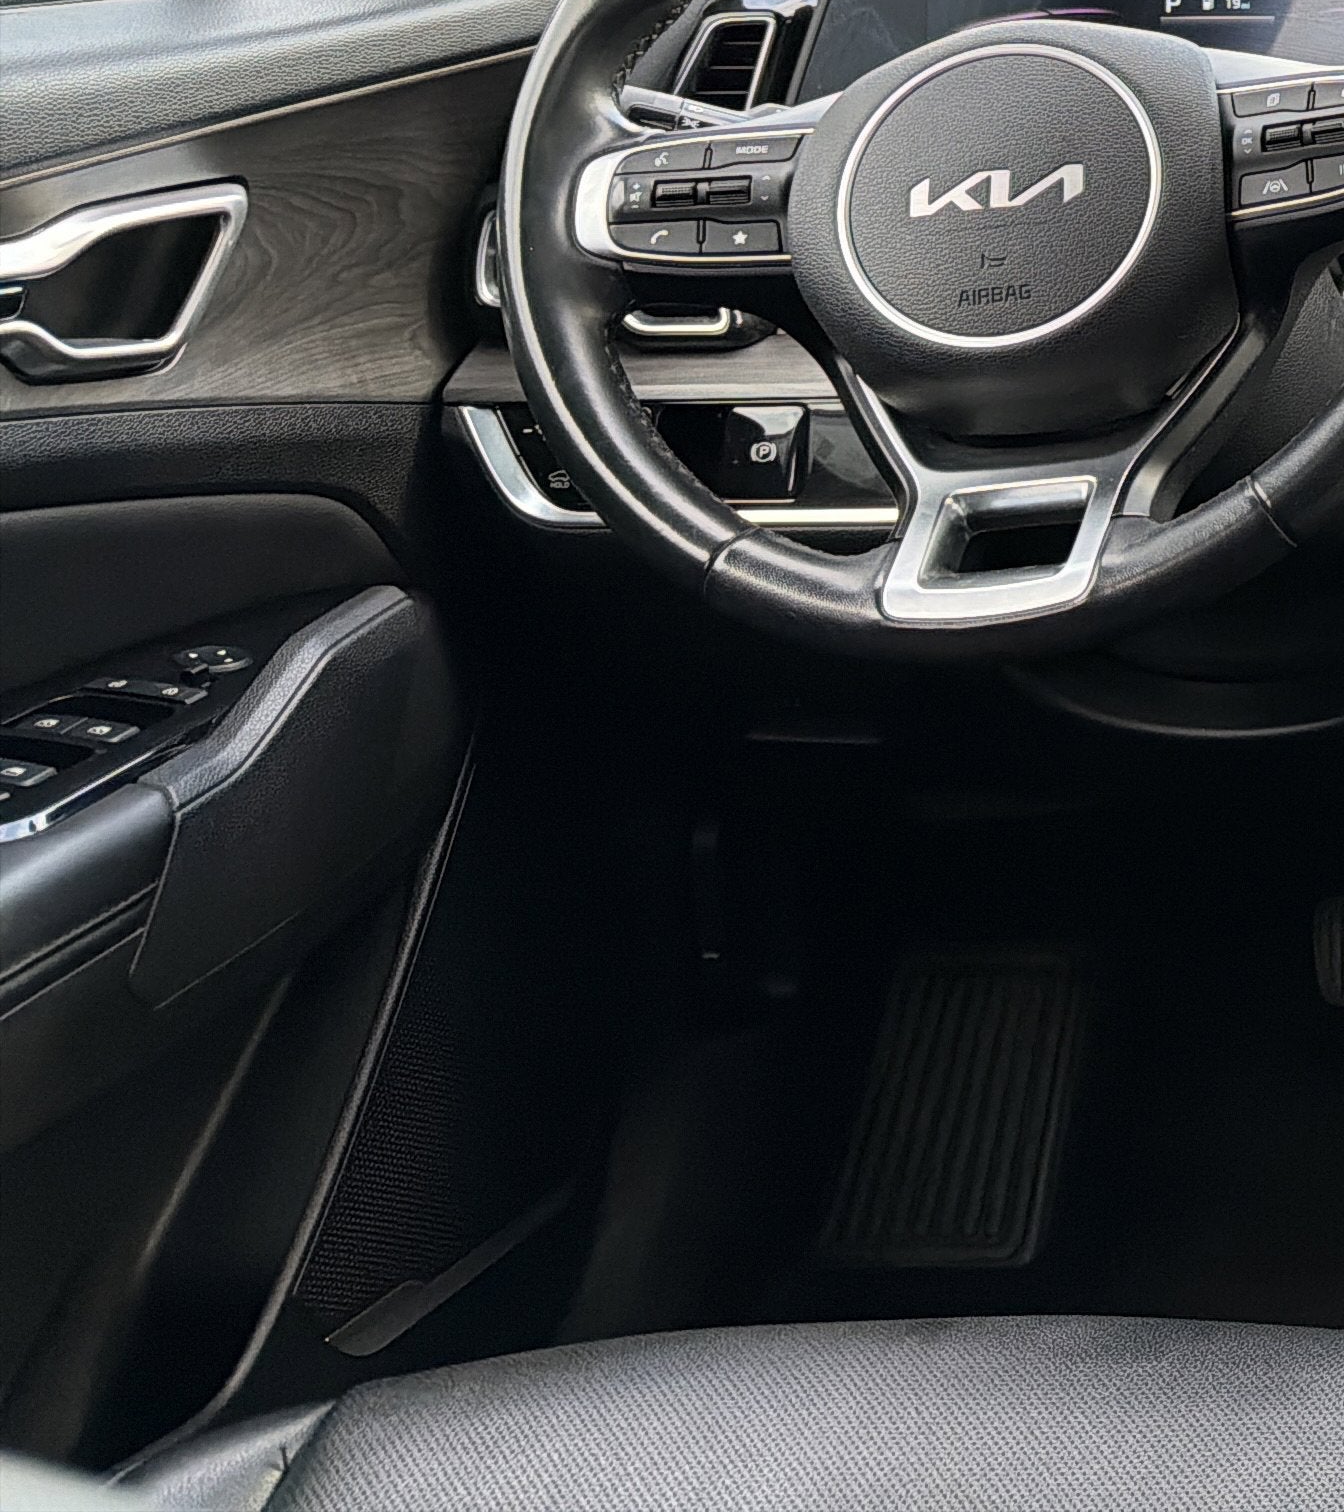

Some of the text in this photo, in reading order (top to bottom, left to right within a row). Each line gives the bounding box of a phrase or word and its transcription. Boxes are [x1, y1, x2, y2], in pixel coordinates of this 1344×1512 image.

[1241, 137, 1253, 145] OK
[735, 145, 769, 155] MODE
[909, 164, 1084, 218] KIA
[958, 283, 1033, 308] AIRBAG
[549, 481, 570, 489] HOLD
